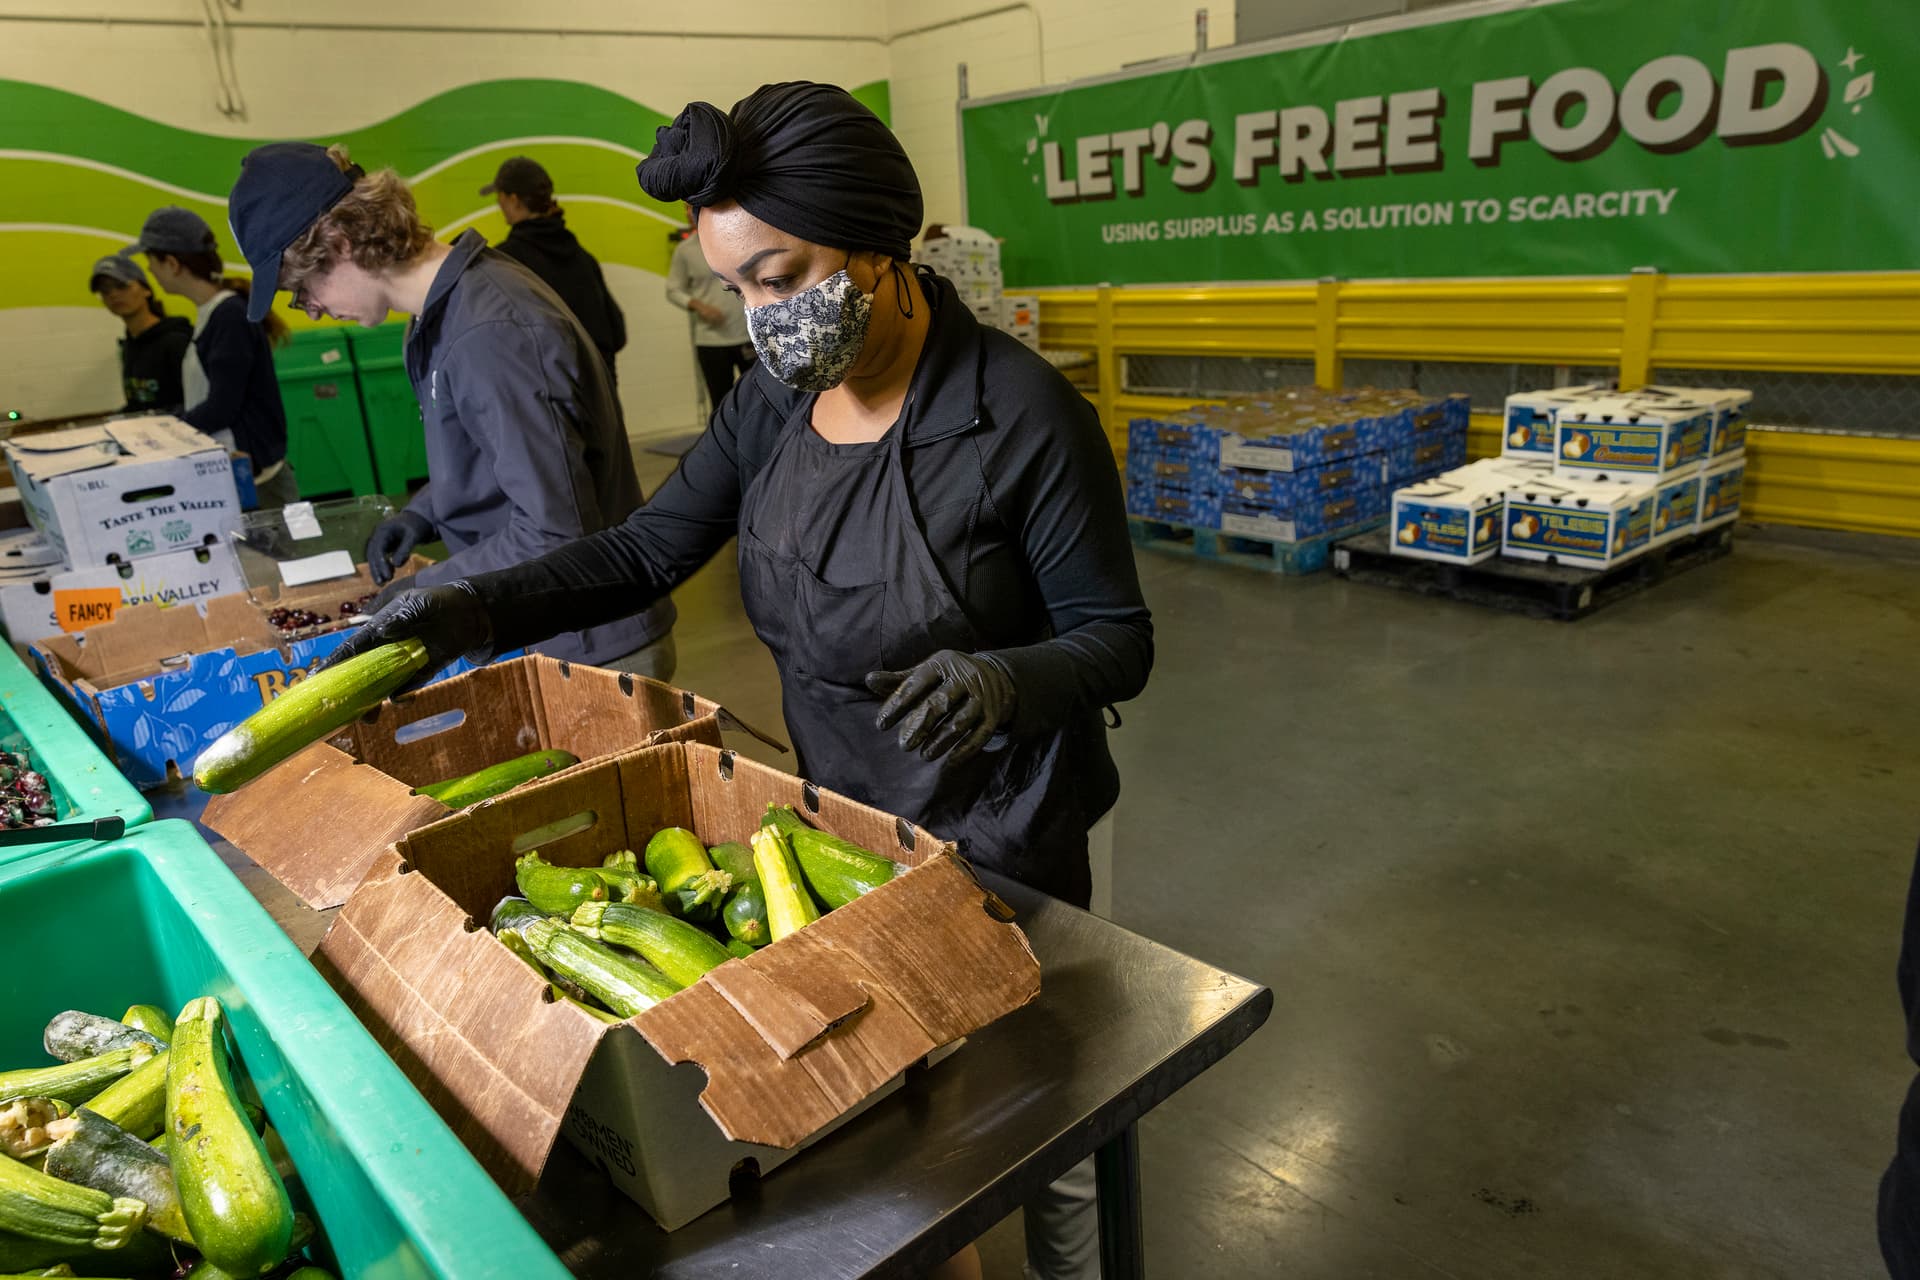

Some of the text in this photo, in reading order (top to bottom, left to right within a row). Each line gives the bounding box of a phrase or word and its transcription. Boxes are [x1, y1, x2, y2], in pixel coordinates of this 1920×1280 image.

[1042, 42, 1829, 204] LET'S FREE FOOD
[1102, 187, 1679, 243] USING SURPLUS AS A SOLUTION TO SCARCITY
[99, 511, 145, 531] TASTE
[146, 504, 176, 518] THE
[157, 578, 221, 604] VALLEY
[69, 602, 113, 623] FANCY
